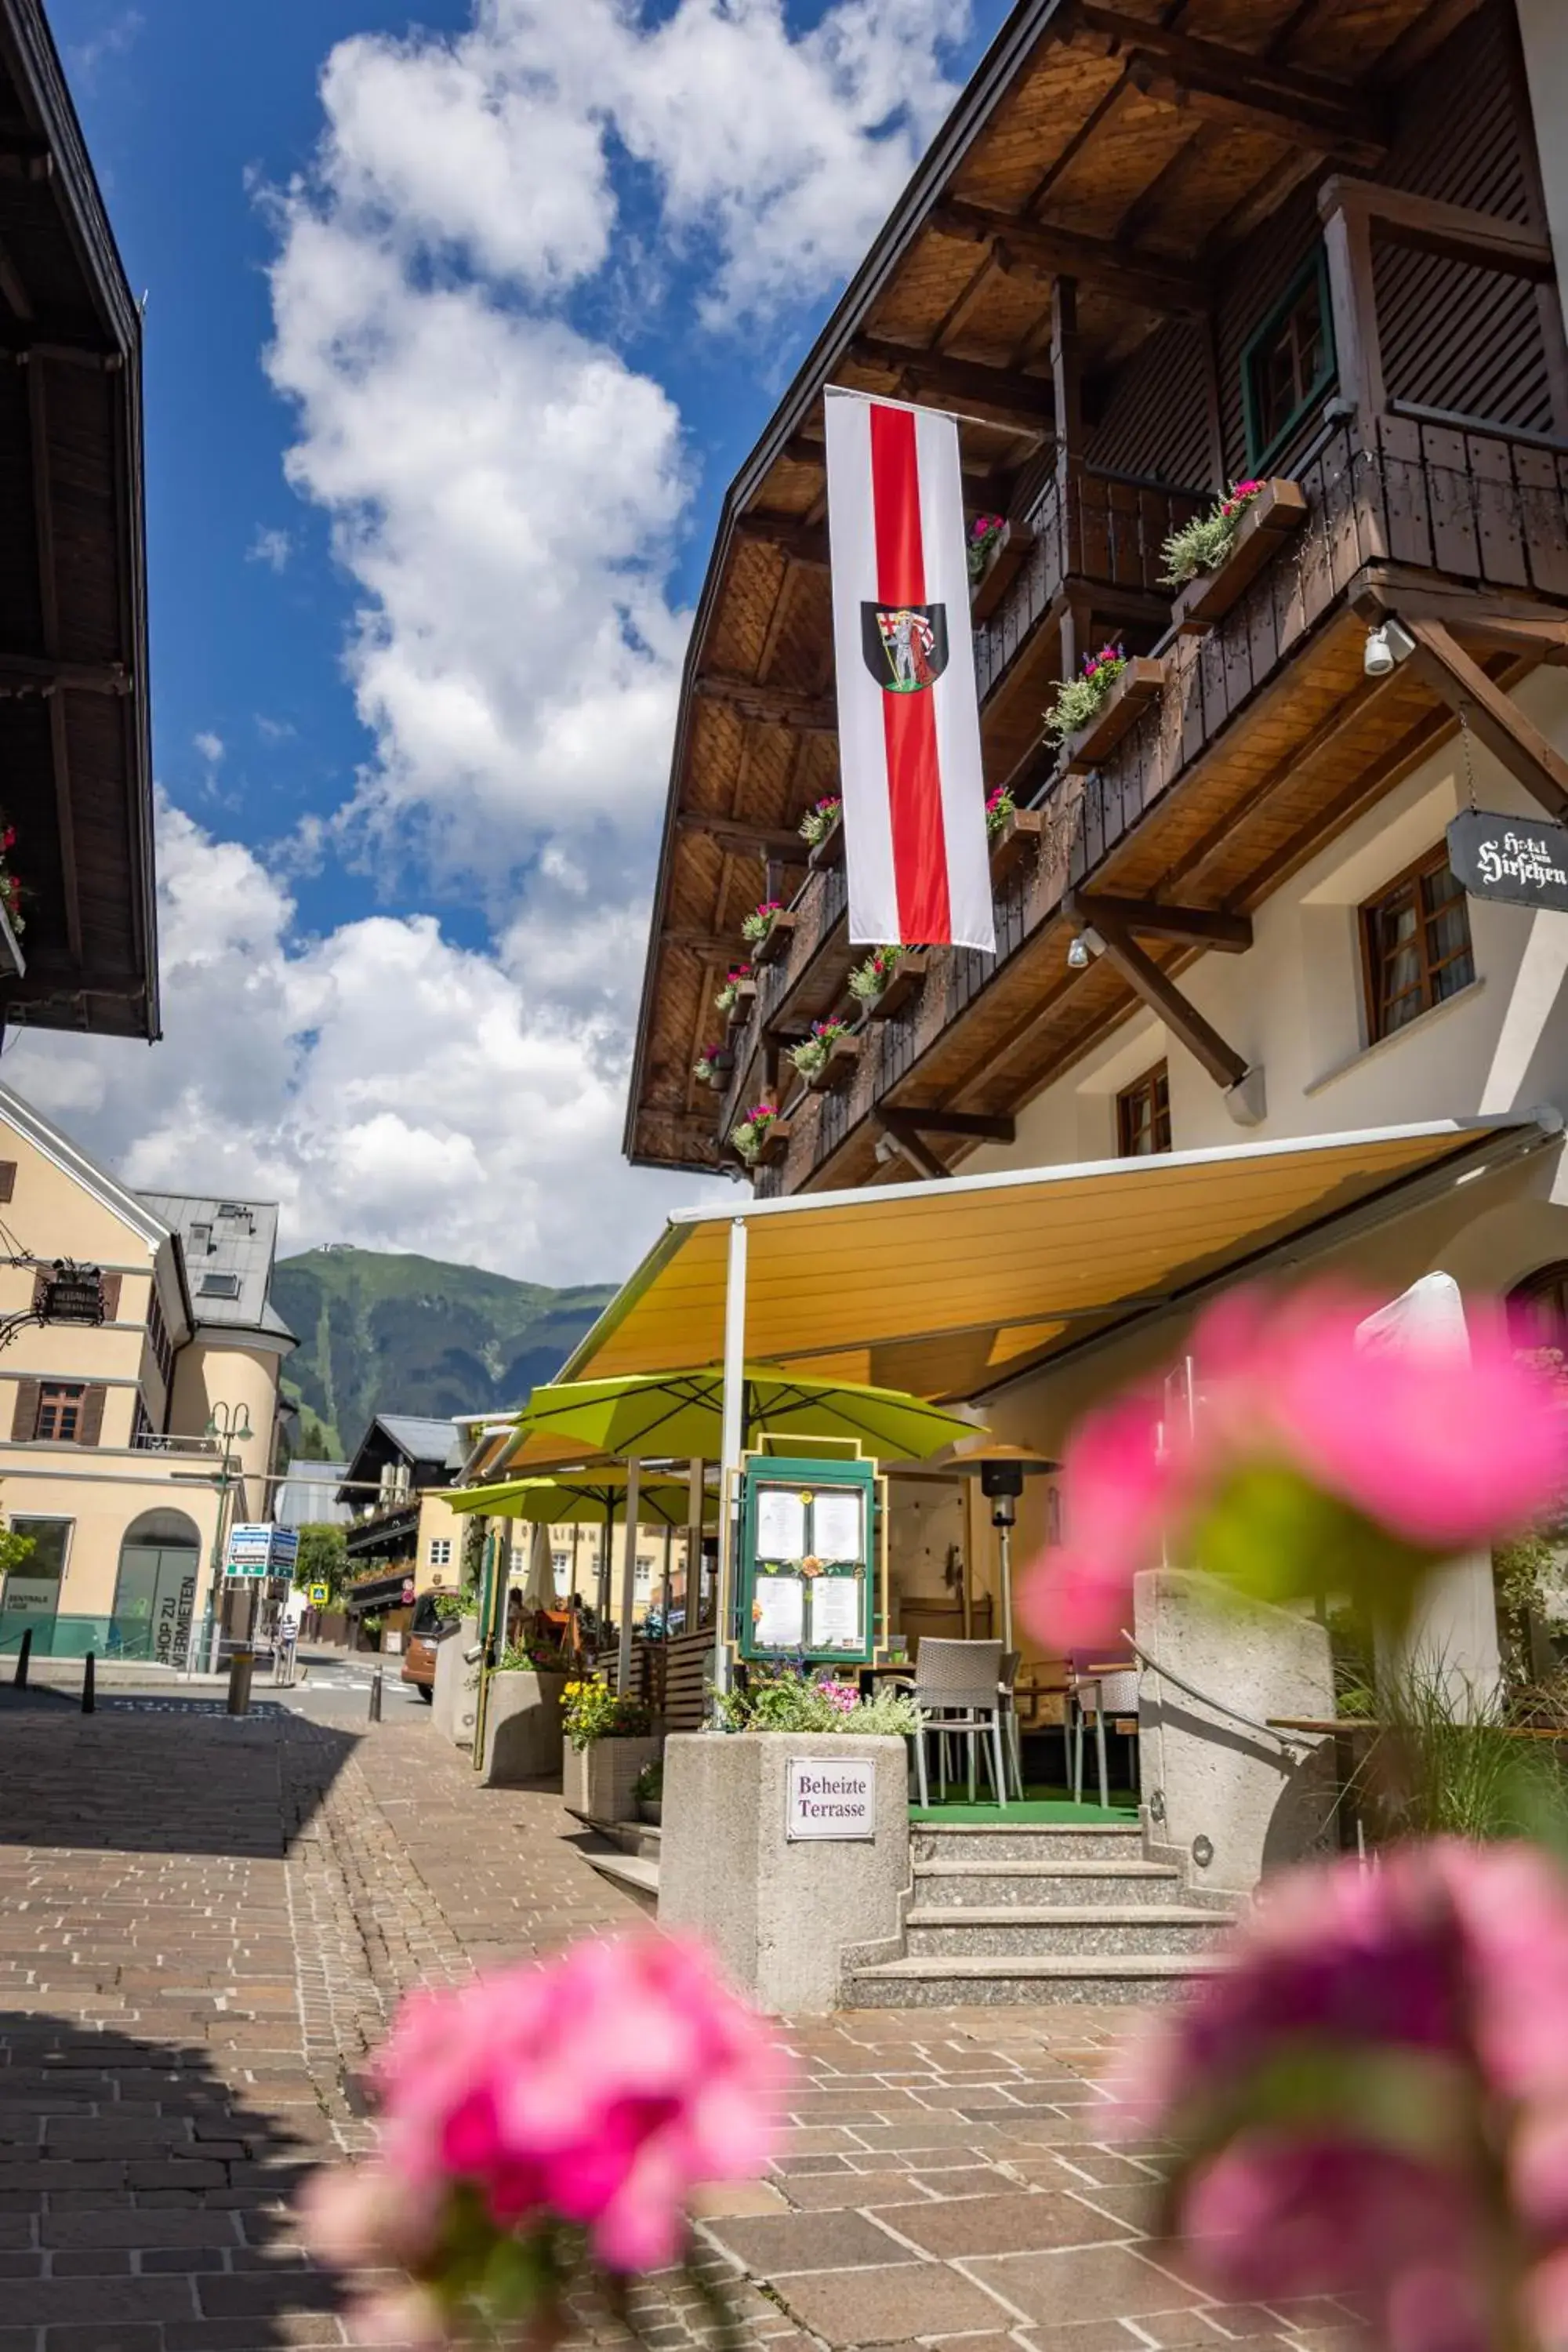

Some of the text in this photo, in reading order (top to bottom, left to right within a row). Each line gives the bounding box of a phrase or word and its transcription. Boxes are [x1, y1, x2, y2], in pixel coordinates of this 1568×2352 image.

[1504, 832, 1548, 855] Hotel
[1477, 840, 1568, 888] Hirschen
[156, 1597, 176, 1665] SHOP ZU
[172, 1576, 195, 1668] VERMIETEN
[799, 1776, 866, 1795] Beheizte
[798, 1799, 866, 1818] Terrasse
